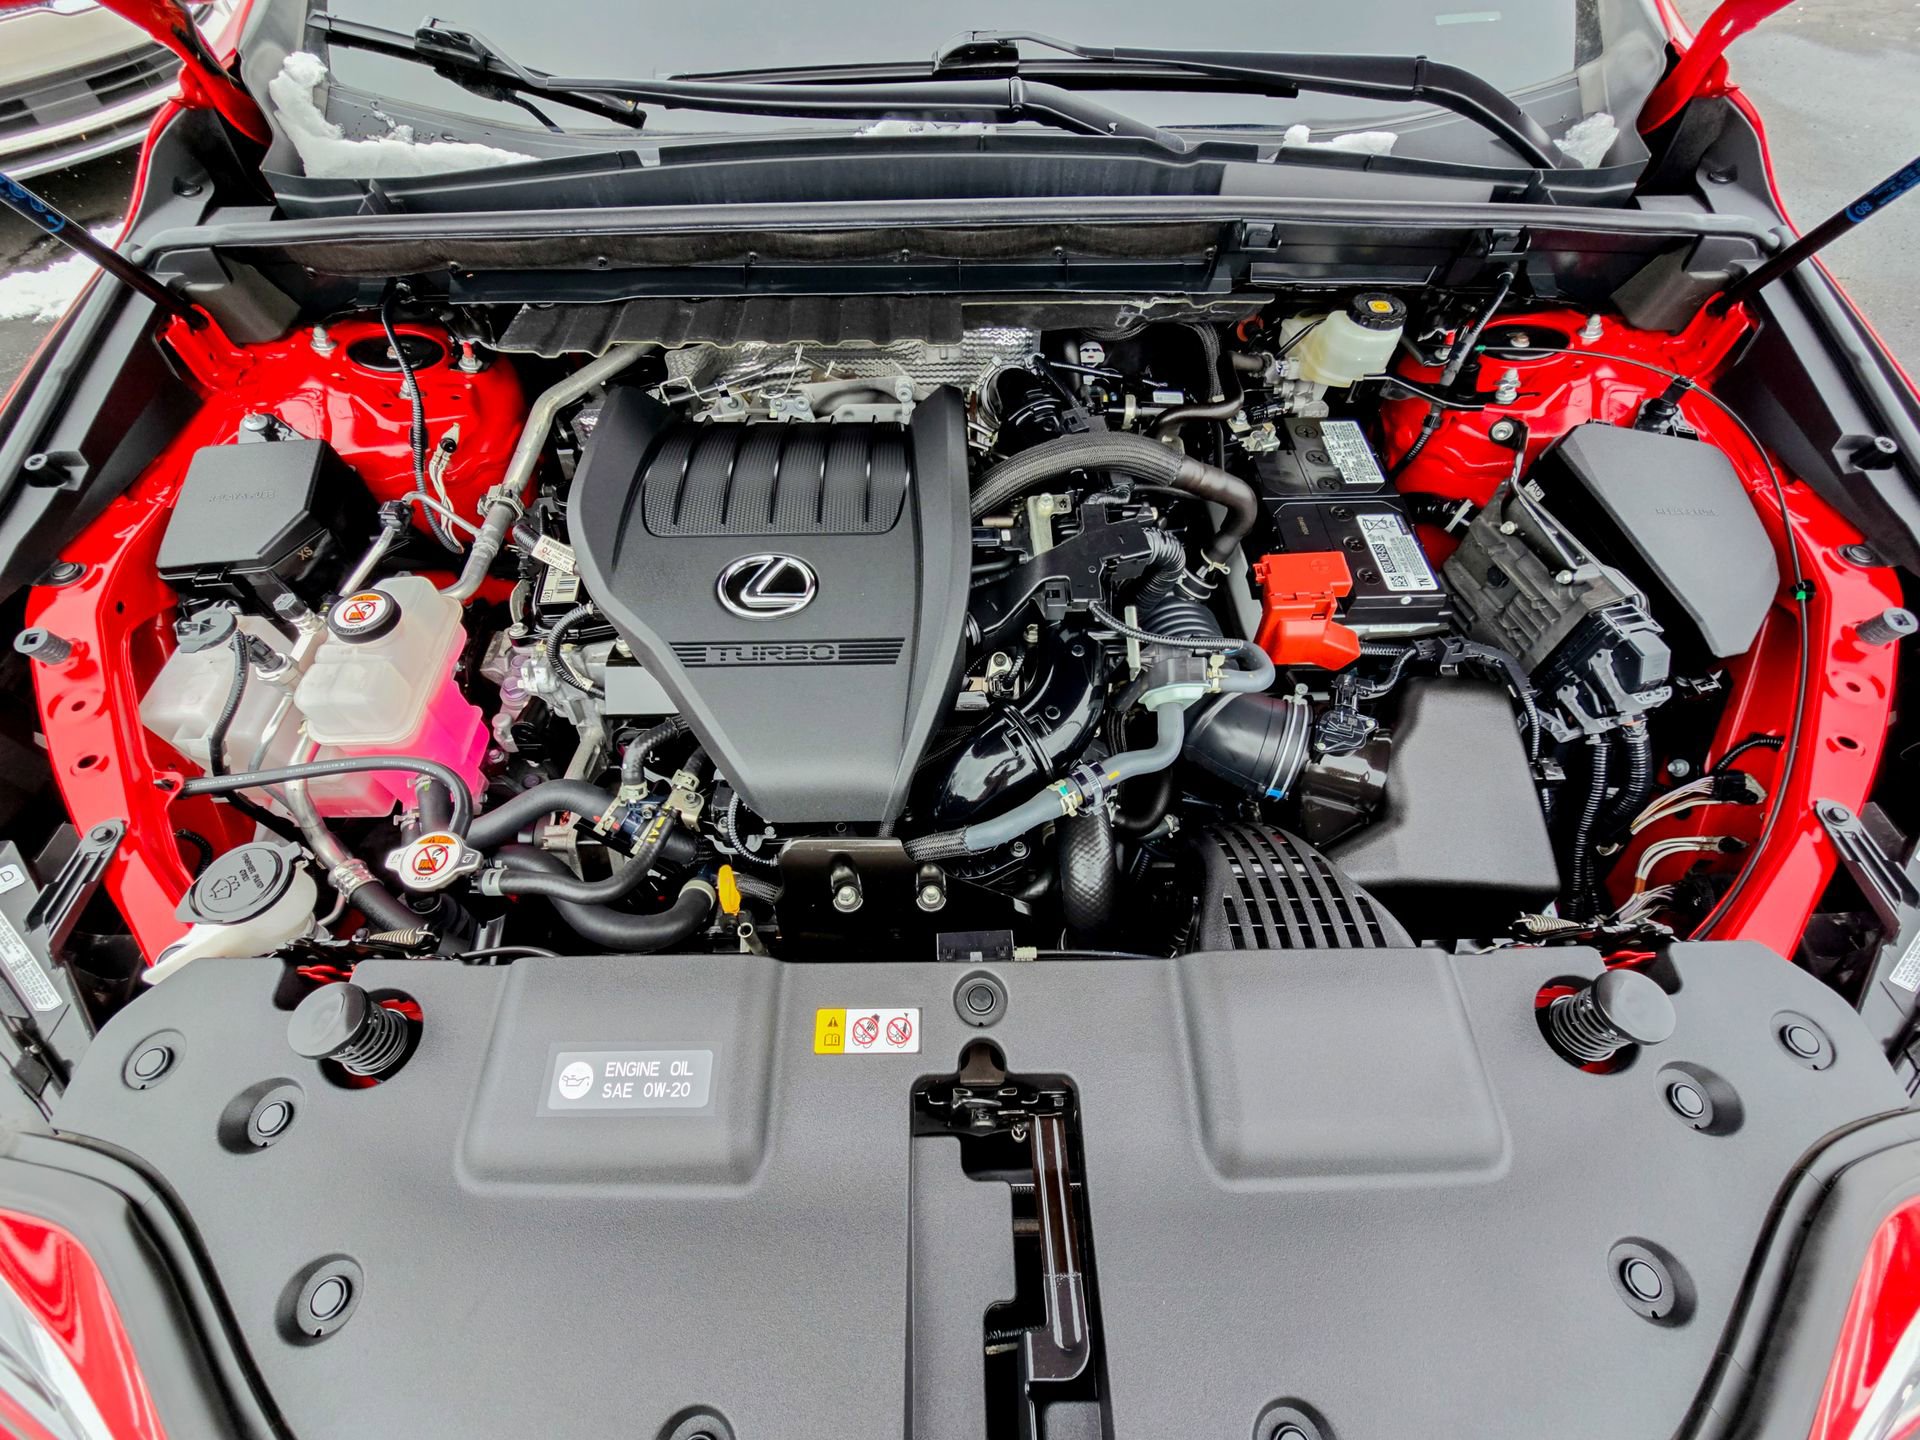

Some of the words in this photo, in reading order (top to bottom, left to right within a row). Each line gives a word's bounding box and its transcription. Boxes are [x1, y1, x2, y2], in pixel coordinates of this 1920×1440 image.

[710, 644, 836, 662] TURBO
[605, 1061, 661, 1077] ENGINE
[670, 1061, 694, 1076] OIL
[602, 1082, 634, 1098] SAE
[643, 1082, 691, 1098] 0W-20
